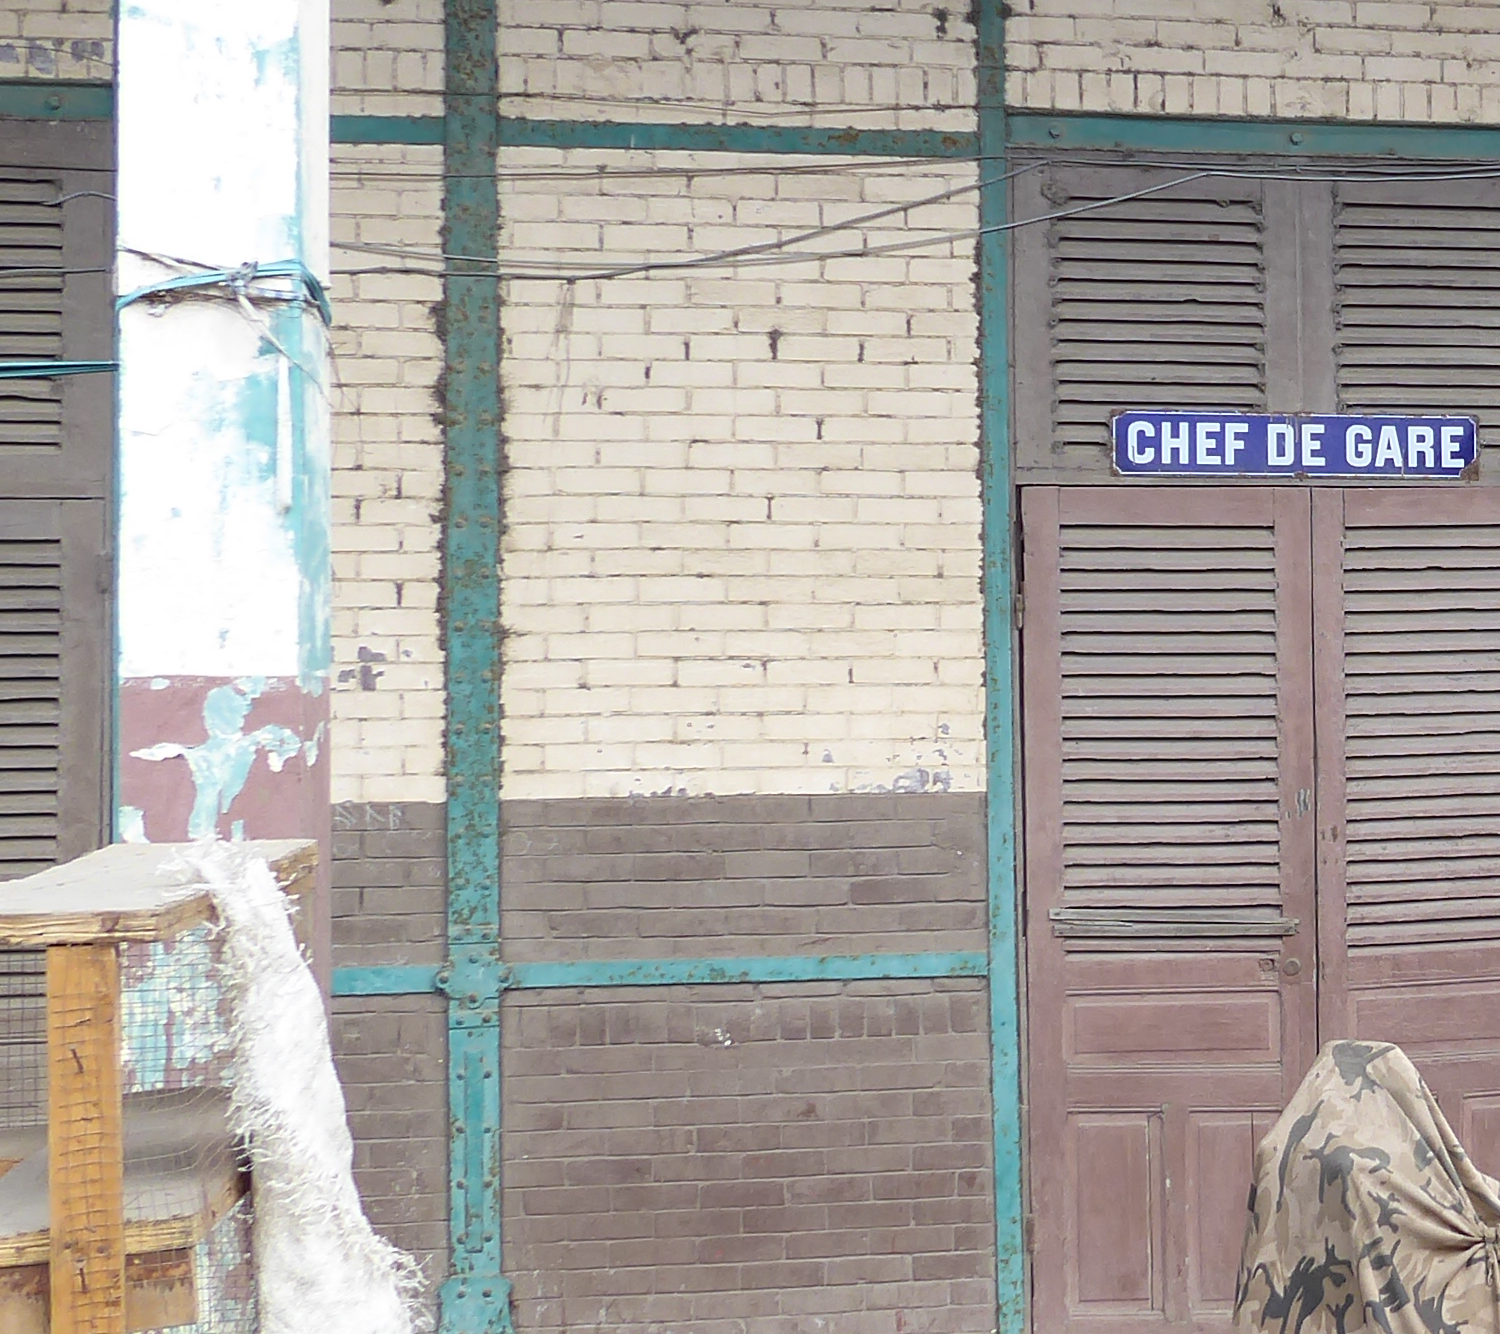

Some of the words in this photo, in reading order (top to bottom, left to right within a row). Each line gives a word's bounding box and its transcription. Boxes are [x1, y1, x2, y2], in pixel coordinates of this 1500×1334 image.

[1127, 420, 1249, 466] CHEF
[1267, 423, 1326, 467] DE
[1345, 424, 1465, 469] GARE
